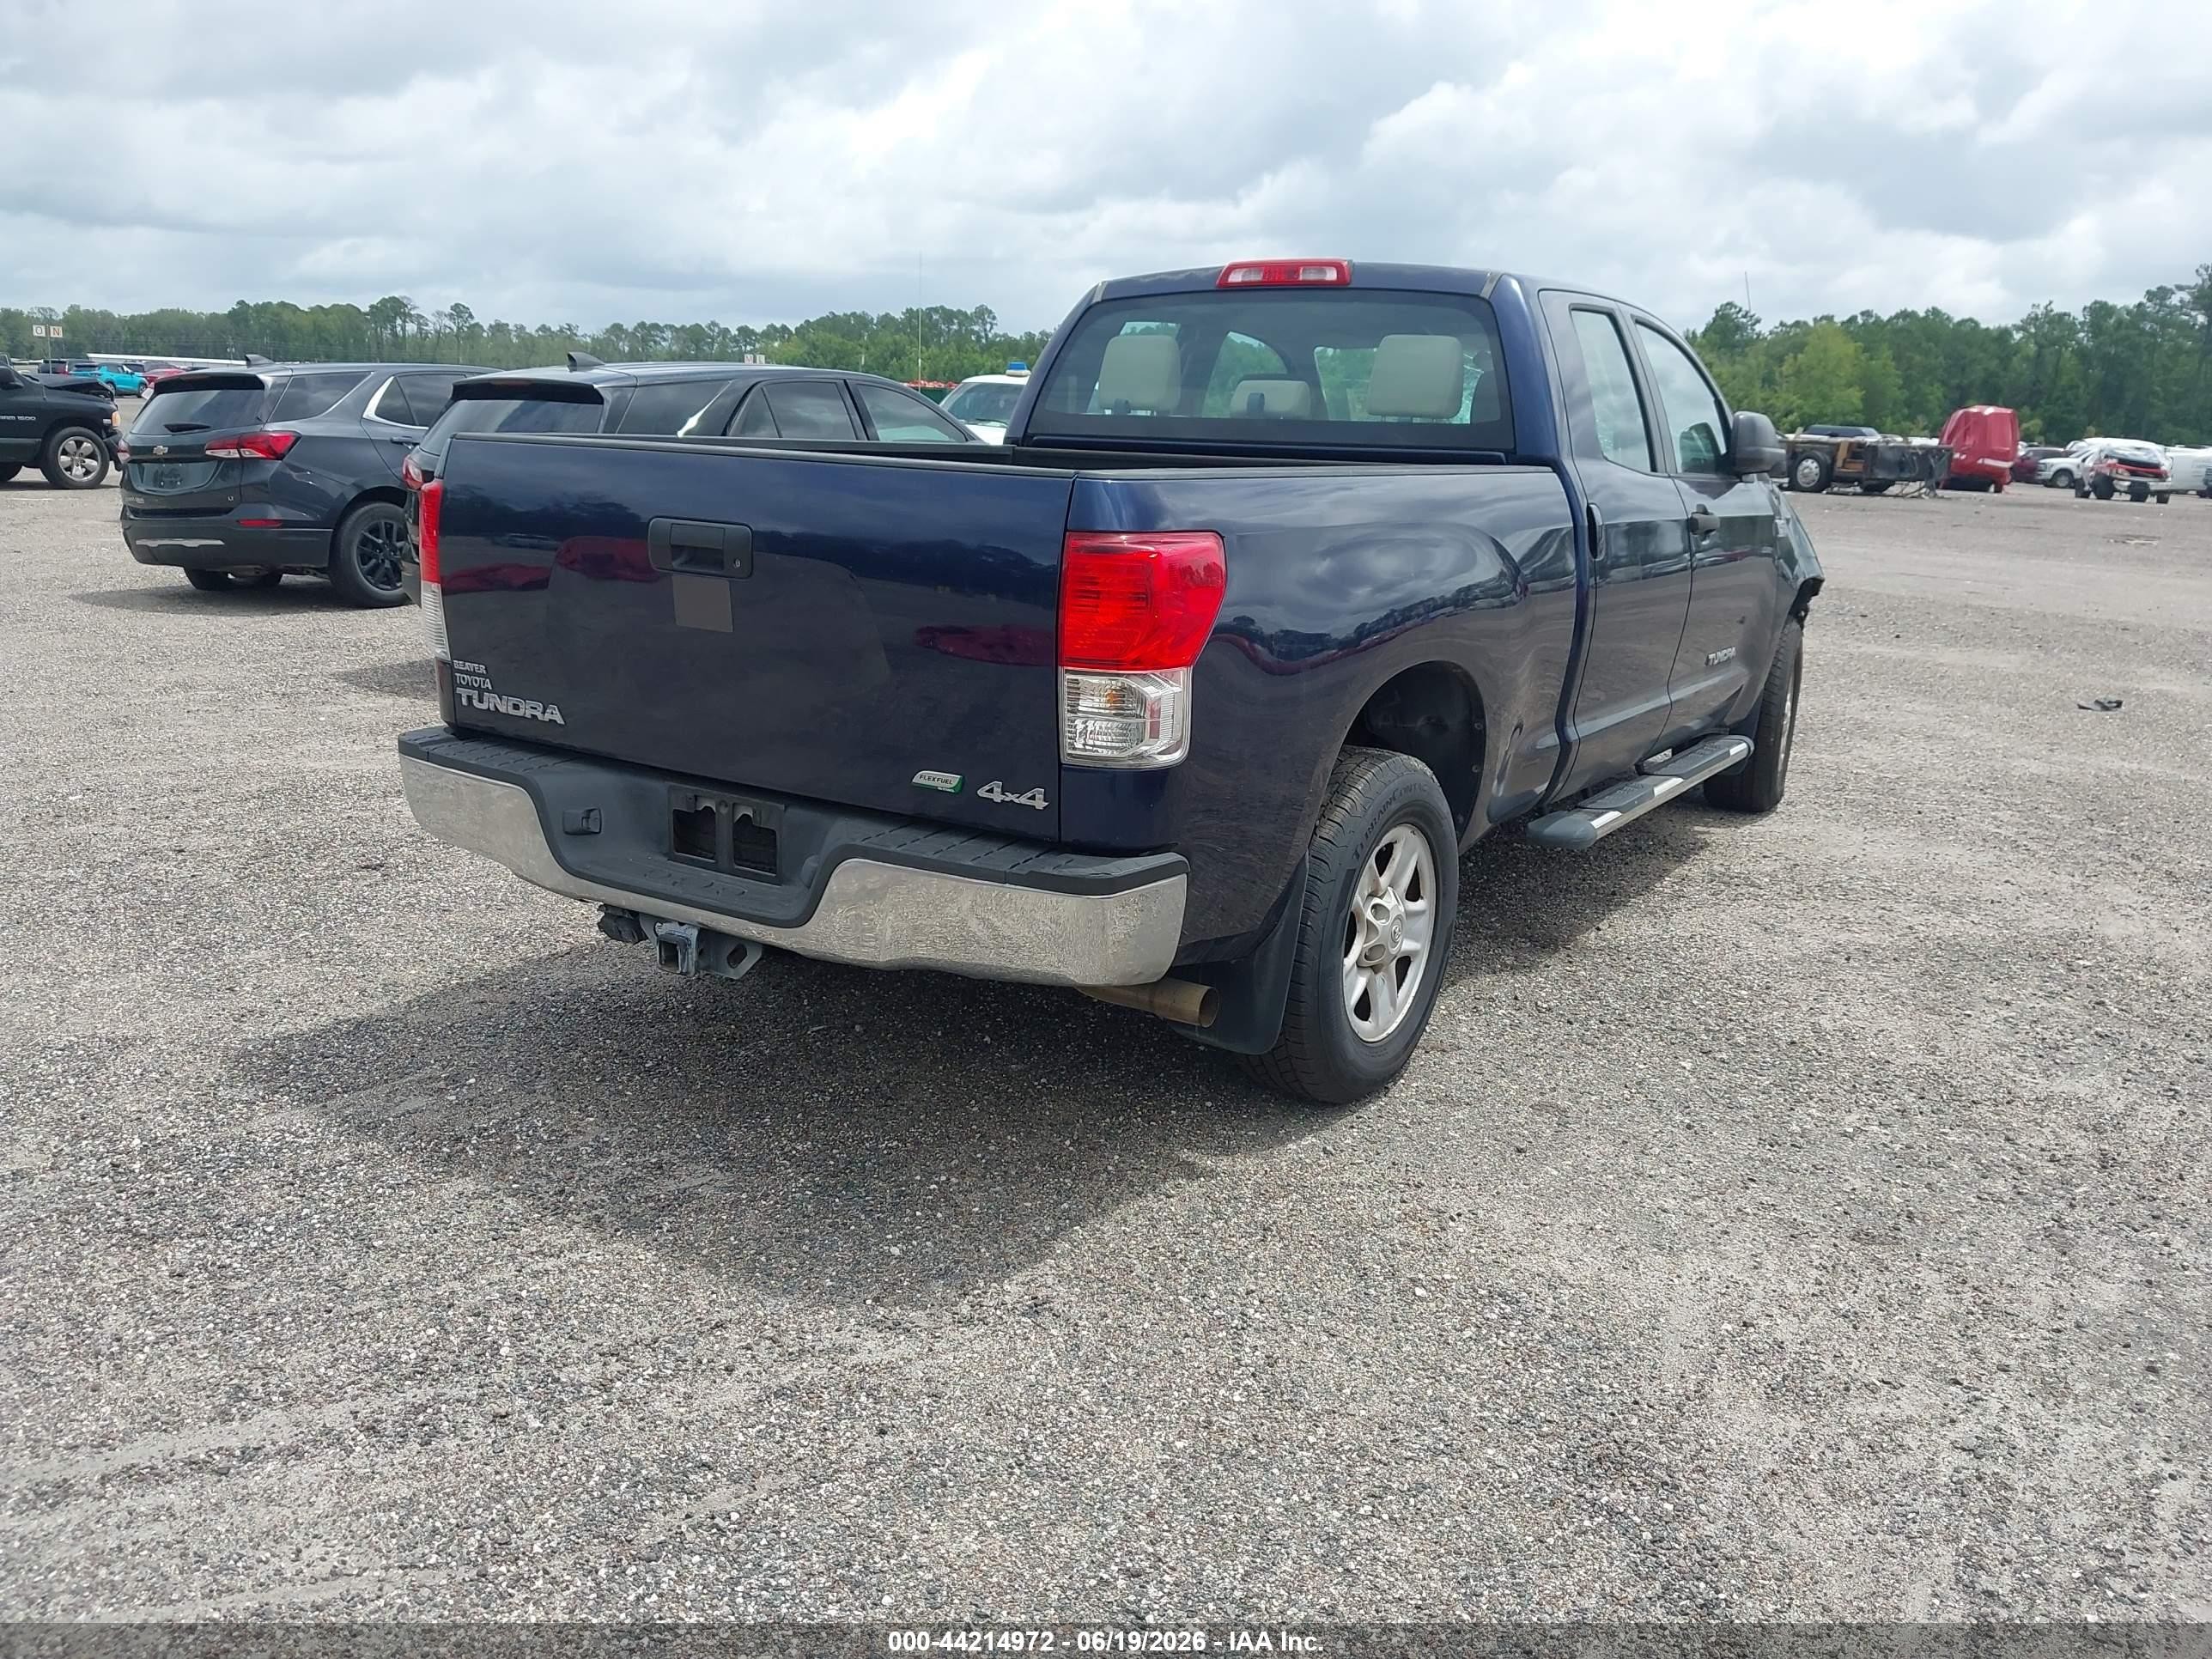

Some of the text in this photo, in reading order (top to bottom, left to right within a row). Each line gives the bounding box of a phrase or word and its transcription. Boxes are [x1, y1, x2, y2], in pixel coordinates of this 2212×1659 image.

[53, 327, 60, 336] N
[453, 660, 487, 674] BEAVER
[454, 672, 493, 690] TOYOTA
[456, 687, 565, 726] TUNDRA
[919, 774, 953, 786] FLEXFUEL
[976, 781, 1050, 810] 4x4
